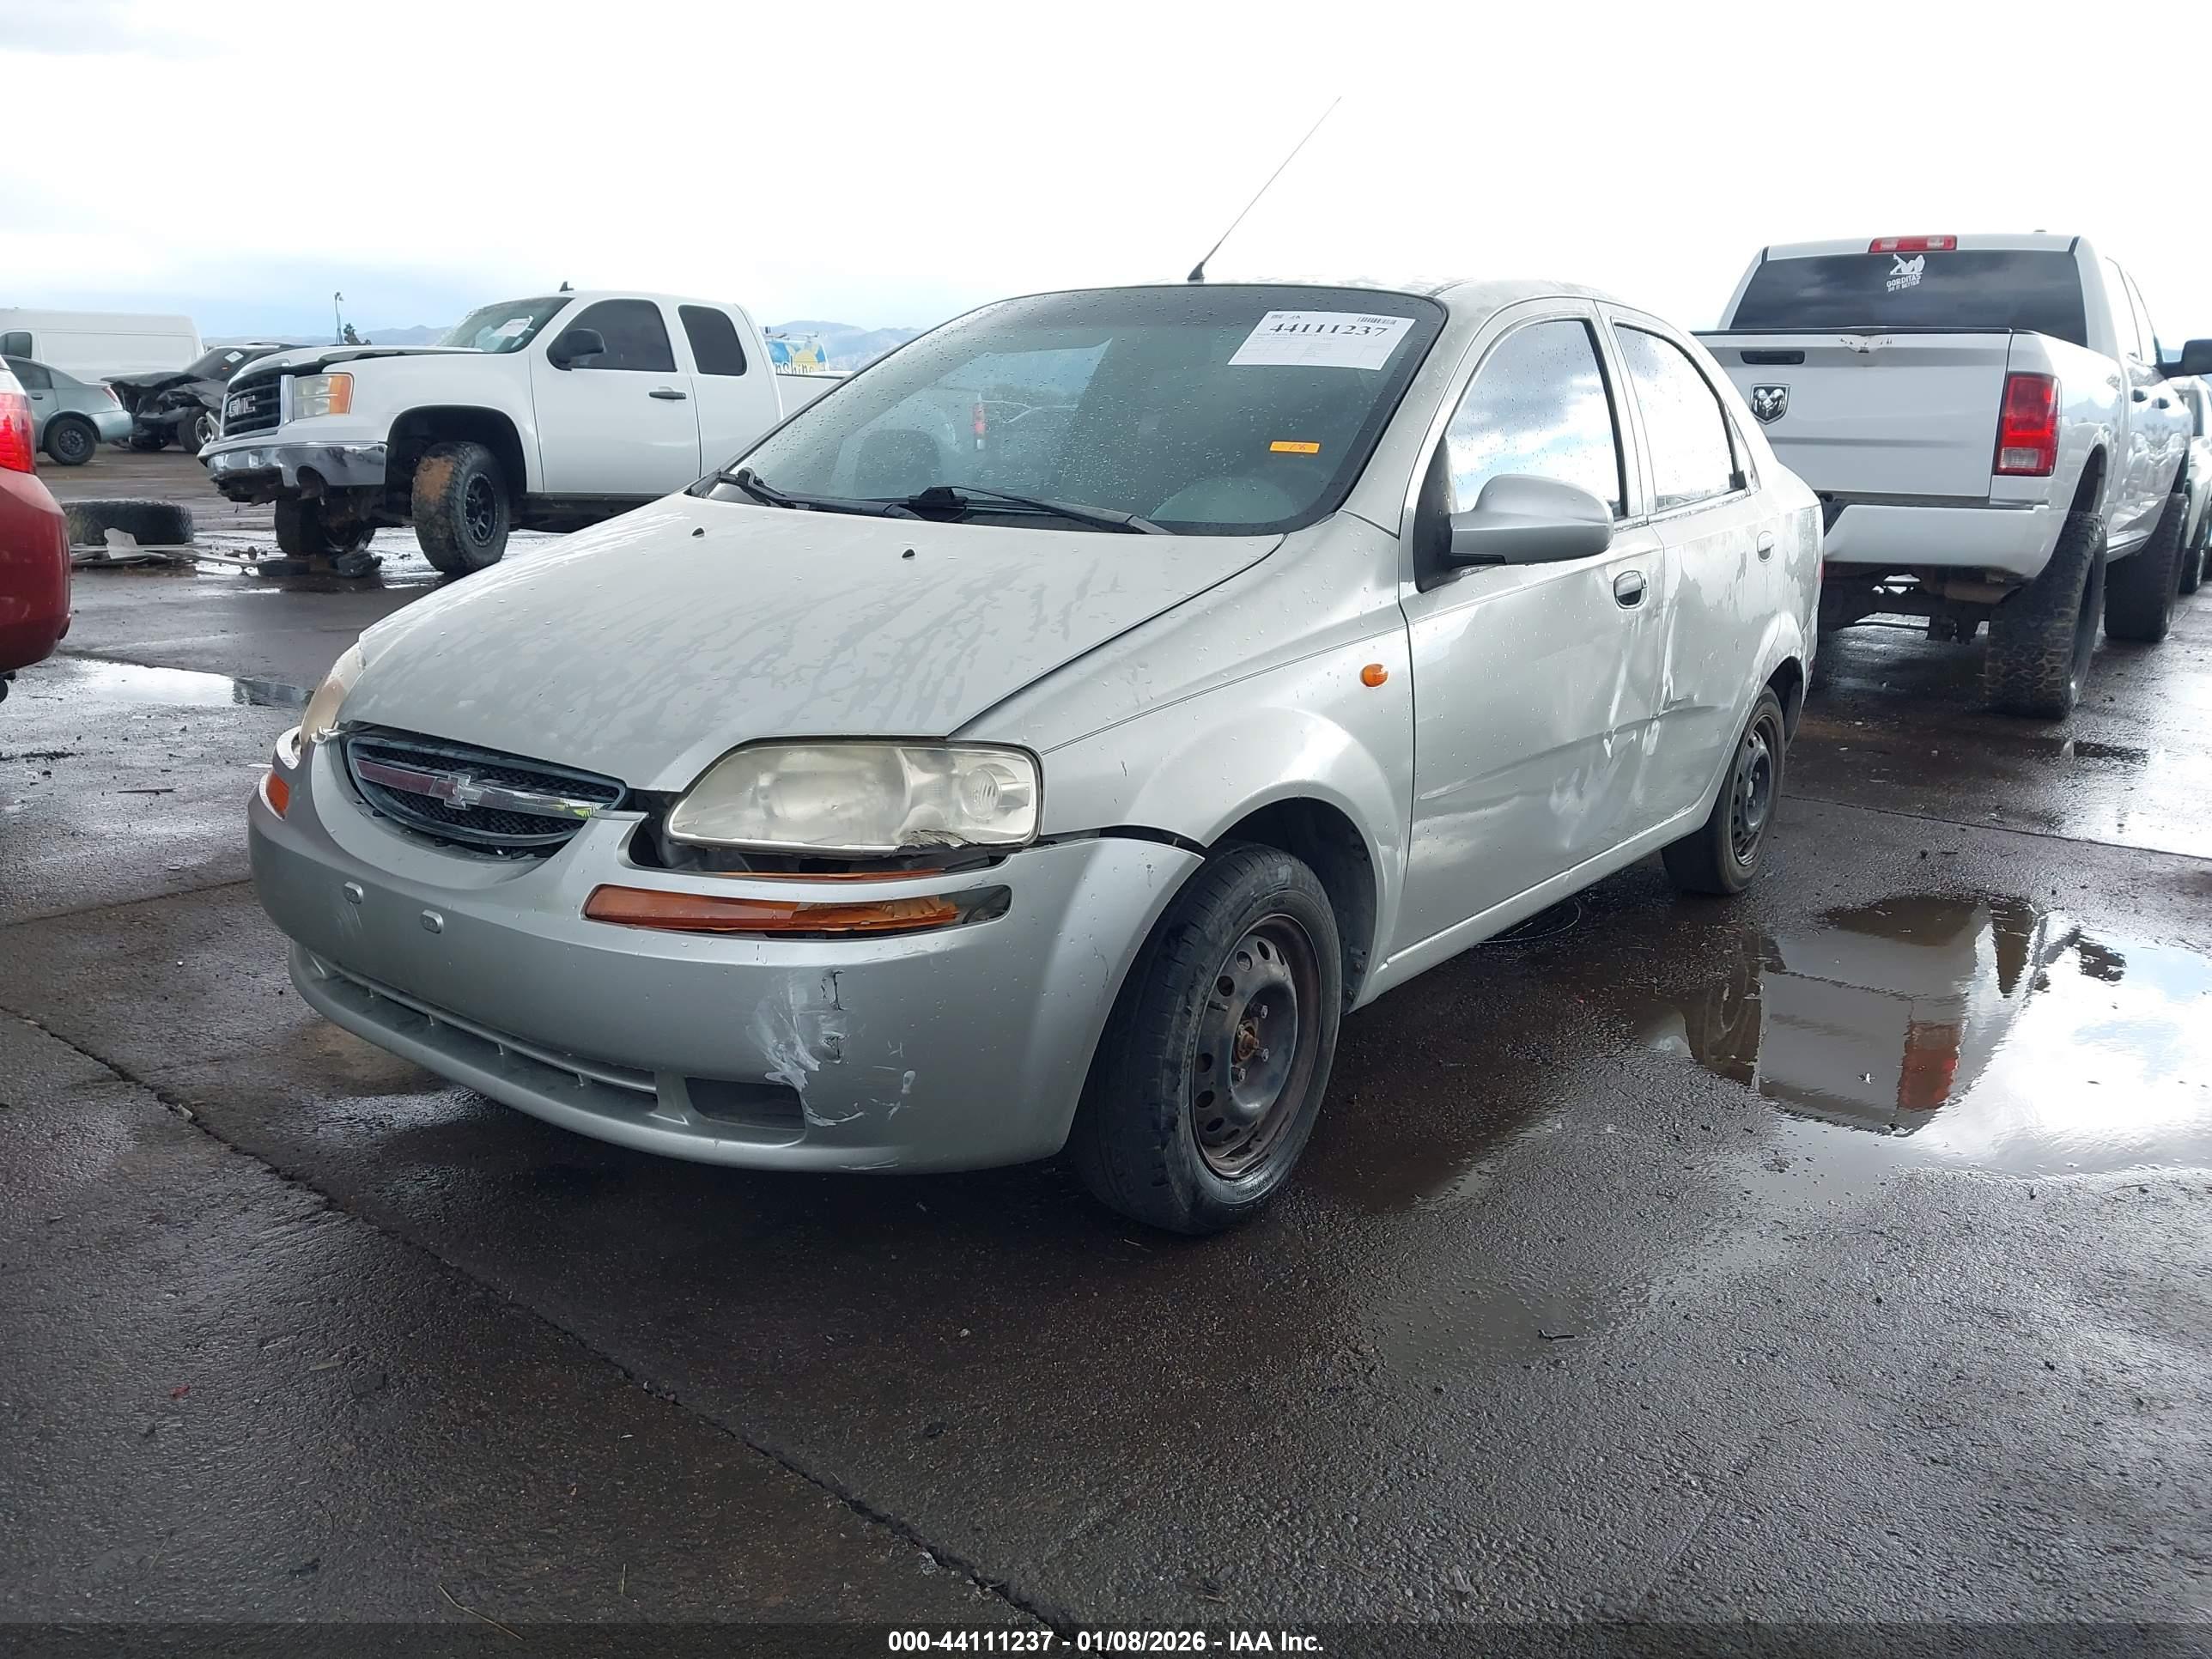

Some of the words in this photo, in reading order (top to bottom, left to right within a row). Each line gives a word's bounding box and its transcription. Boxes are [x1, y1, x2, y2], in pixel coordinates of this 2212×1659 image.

[1887, 274, 1921, 288] GORDITAS
[1269, 322, 1389, 337] 44111237
[229, 396, 255, 417] GMC
